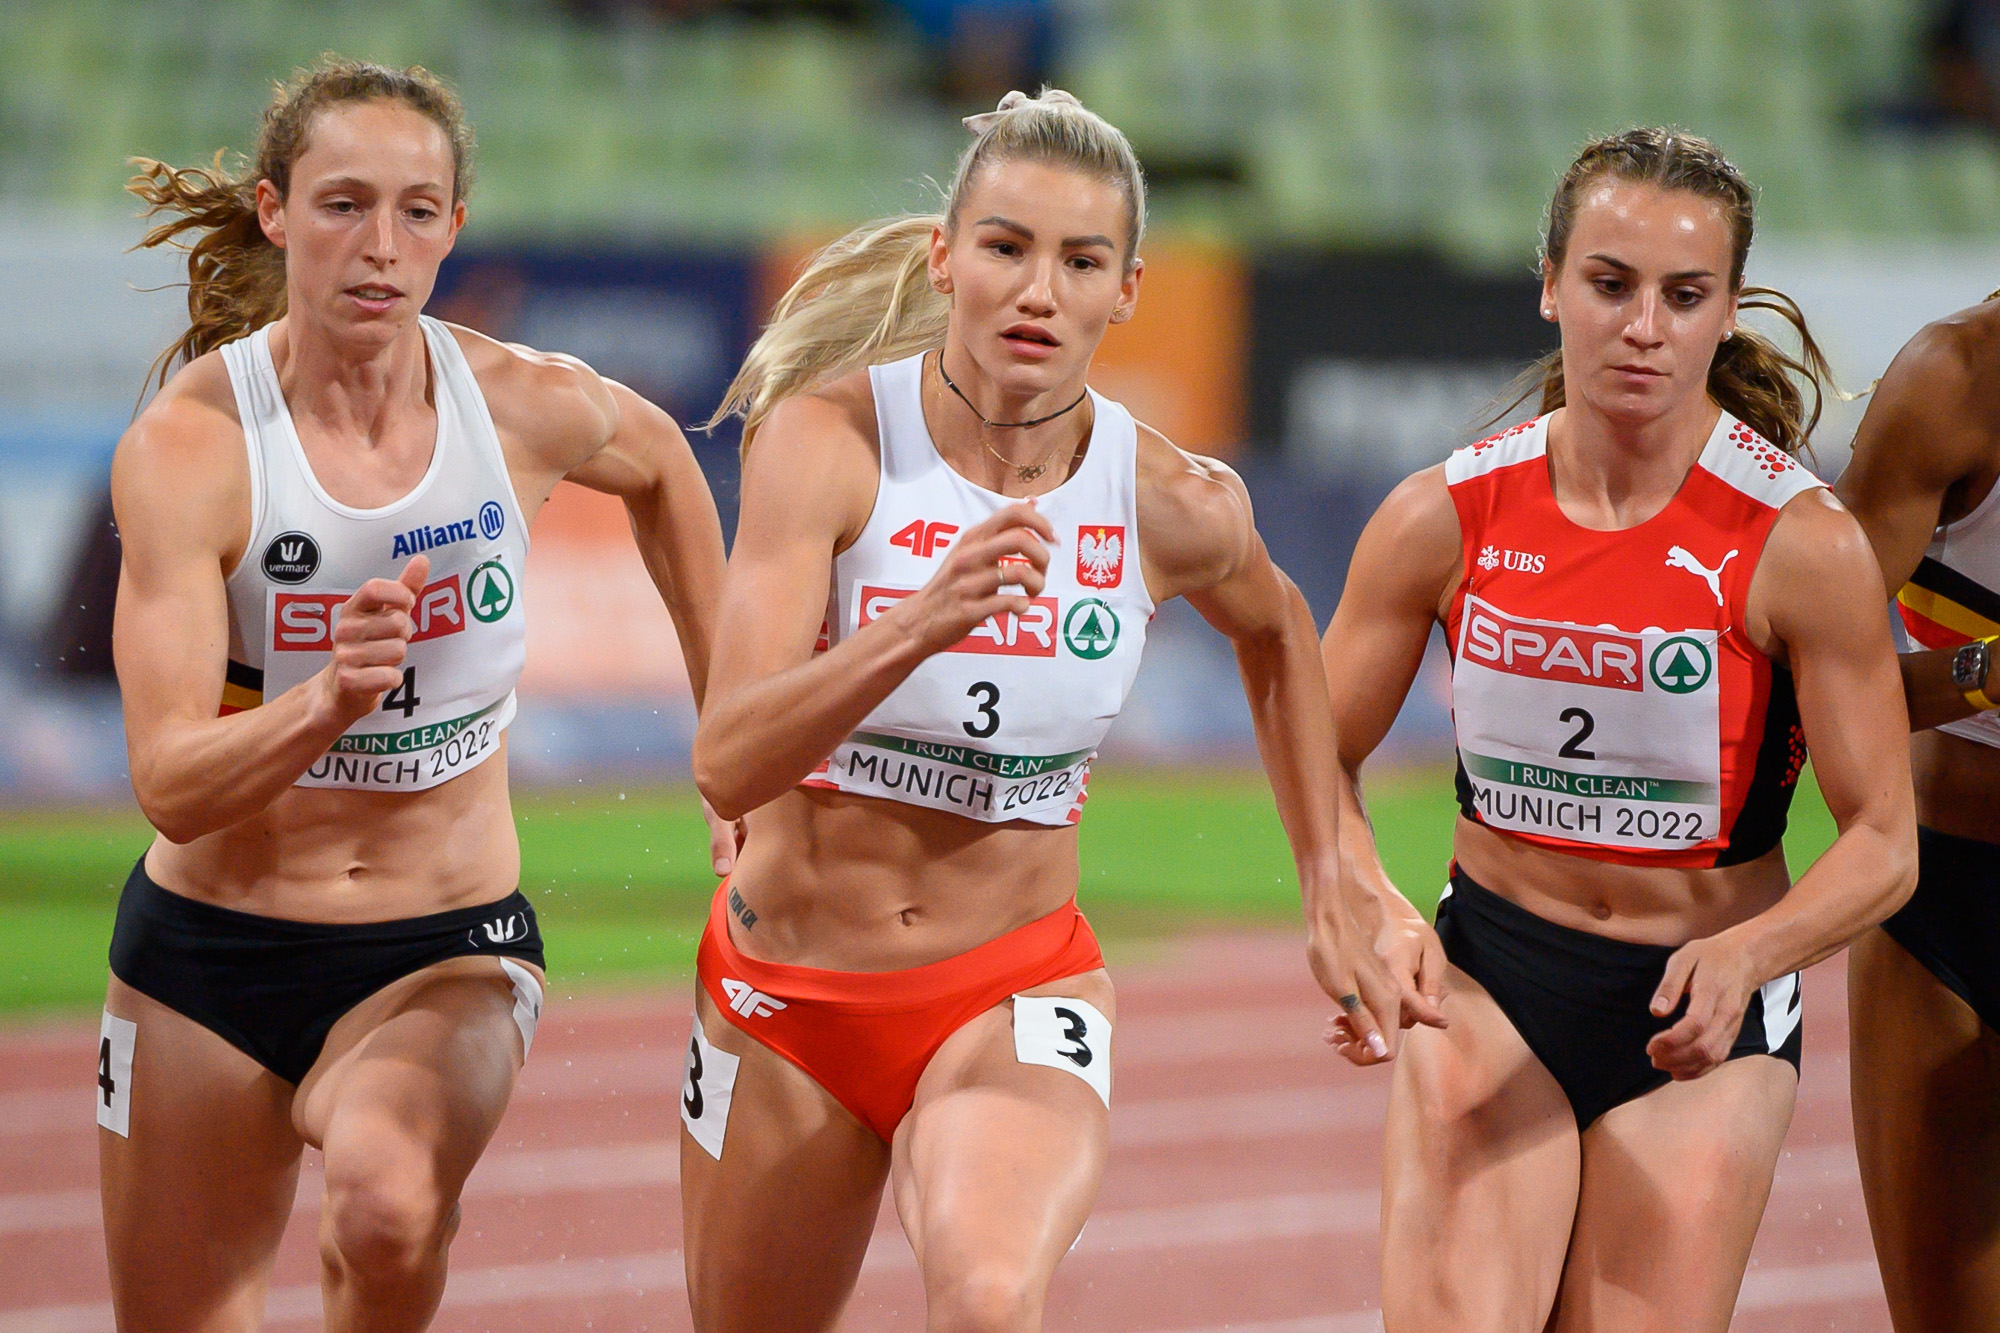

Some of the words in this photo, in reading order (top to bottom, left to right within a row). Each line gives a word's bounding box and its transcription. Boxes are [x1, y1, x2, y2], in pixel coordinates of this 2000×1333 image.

[392, 518, 477, 560] Allianz
[889, 519, 960, 558] 4F
[1503, 549, 1546, 574] UBS
[269, 563, 311, 574] vermarc
[1468, 614, 1637, 683] SPAR
[381, 664, 421, 719] 4
[962, 680, 1001, 739] 3
[340, 736, 389, 753] RUN
[430, 720, 496, 778] 2022
[902, 740, 908, 751] I
[916, 742, 965, 764] RUN
[1557, 706, 1596, 761] 2
[849, 750, 994, 812] MUNICH
[1003, 772, 1071, 811] 2022
[1510, 765, 1515, 782] I
[1523, 767, 1568, 791] RUN
[1473, 782, 1601, 834] MUNICH
[1616, 807, 1702, 841] 2022
[721, 977, 788, 1019] 4F
[1054, 1006, 1093, 1068] 3
[98, 1036, 116, 1109] 4
[683, 1035, 704, 1120] 3
